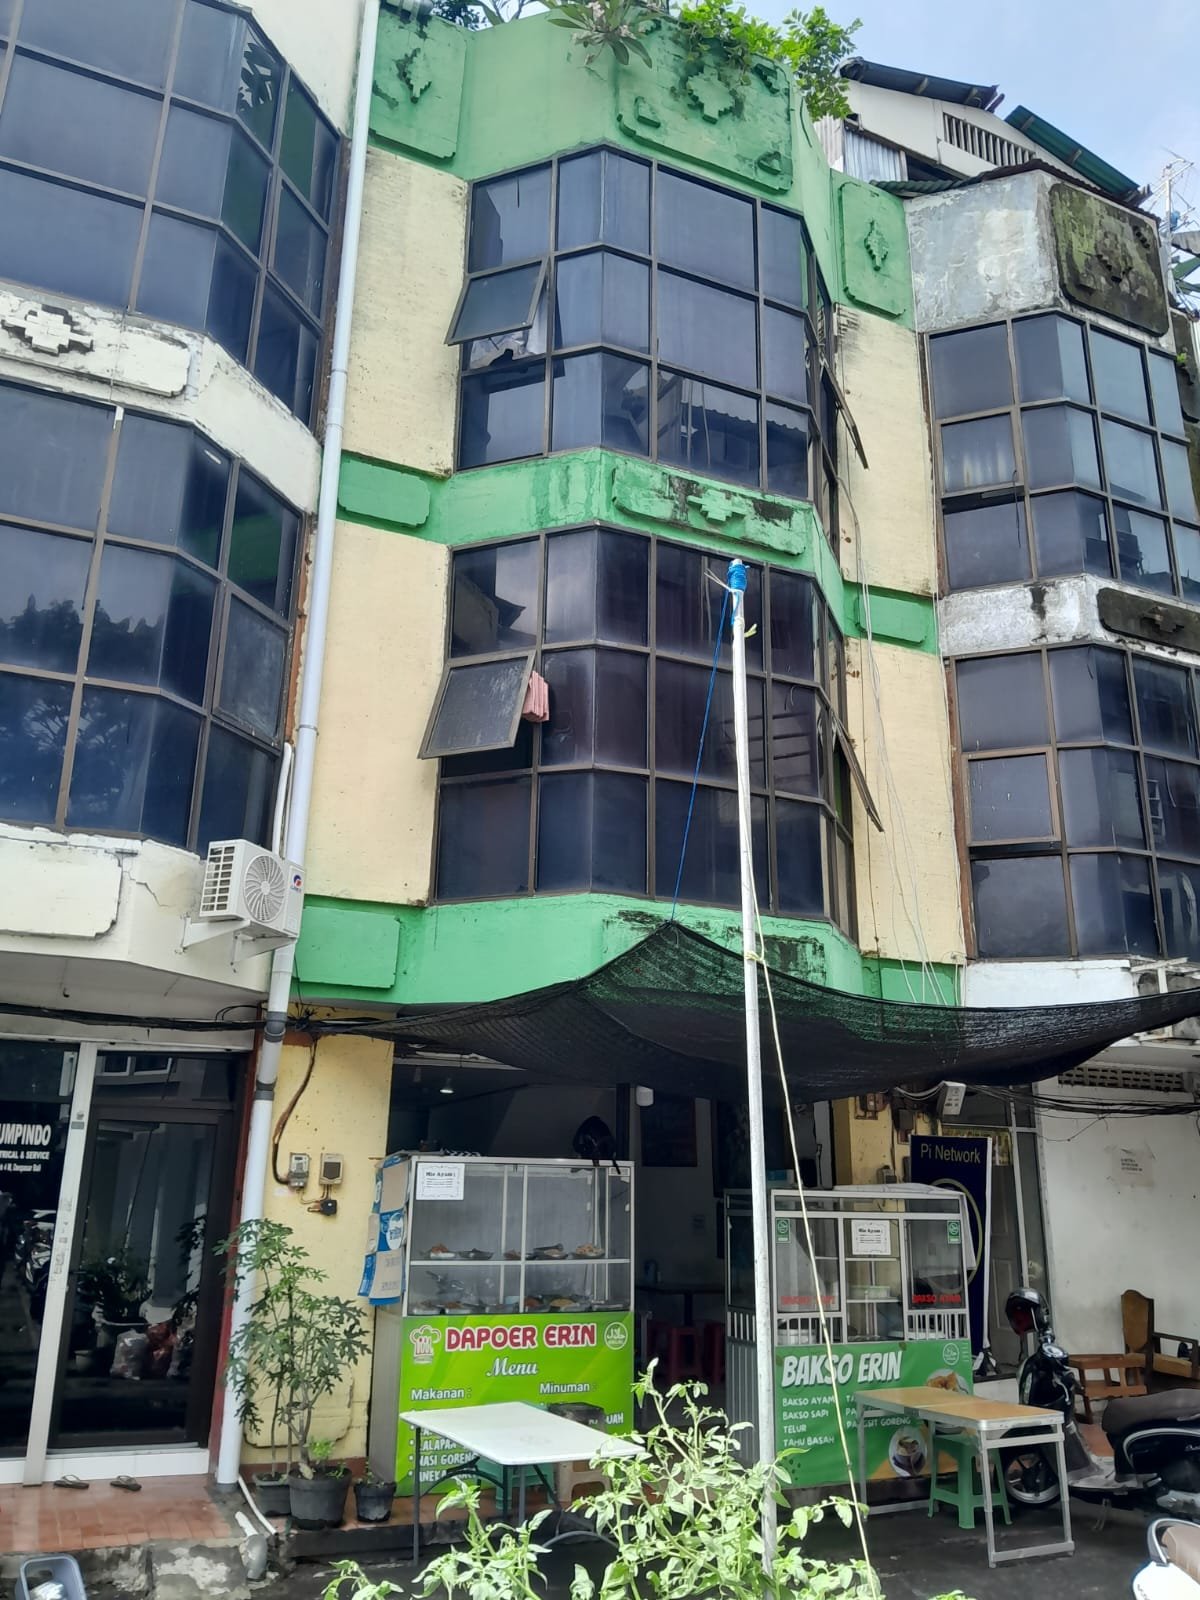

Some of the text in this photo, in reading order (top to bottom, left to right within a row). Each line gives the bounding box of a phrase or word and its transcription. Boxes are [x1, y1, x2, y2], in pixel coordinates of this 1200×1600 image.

[0, 1123, 52, 1146] UMPINDO
[26, 1151, 50, 1160] SERVICE
[920, 1143, 981, 1164] Pi Network
[445, 1323, 597, 1351] DAPOER ERIN
[486, 1357, 539, 1377] Menu
[781, 1350, 903, 1387] BAKSO ERIN
[539, 1382, 590, 1394] Minuman
[411, 1388, 465, 1401] Makanan
[782, 1397, 809, 1407] BAKSO
[782, 1408, 829, 1420] BAKSO SAPI
[880, 1416, 911, 1426] GORENG
[783, 1424, 807, 1434] TELUR
[783, 1436, 835, 1447] TAHU BASAH
